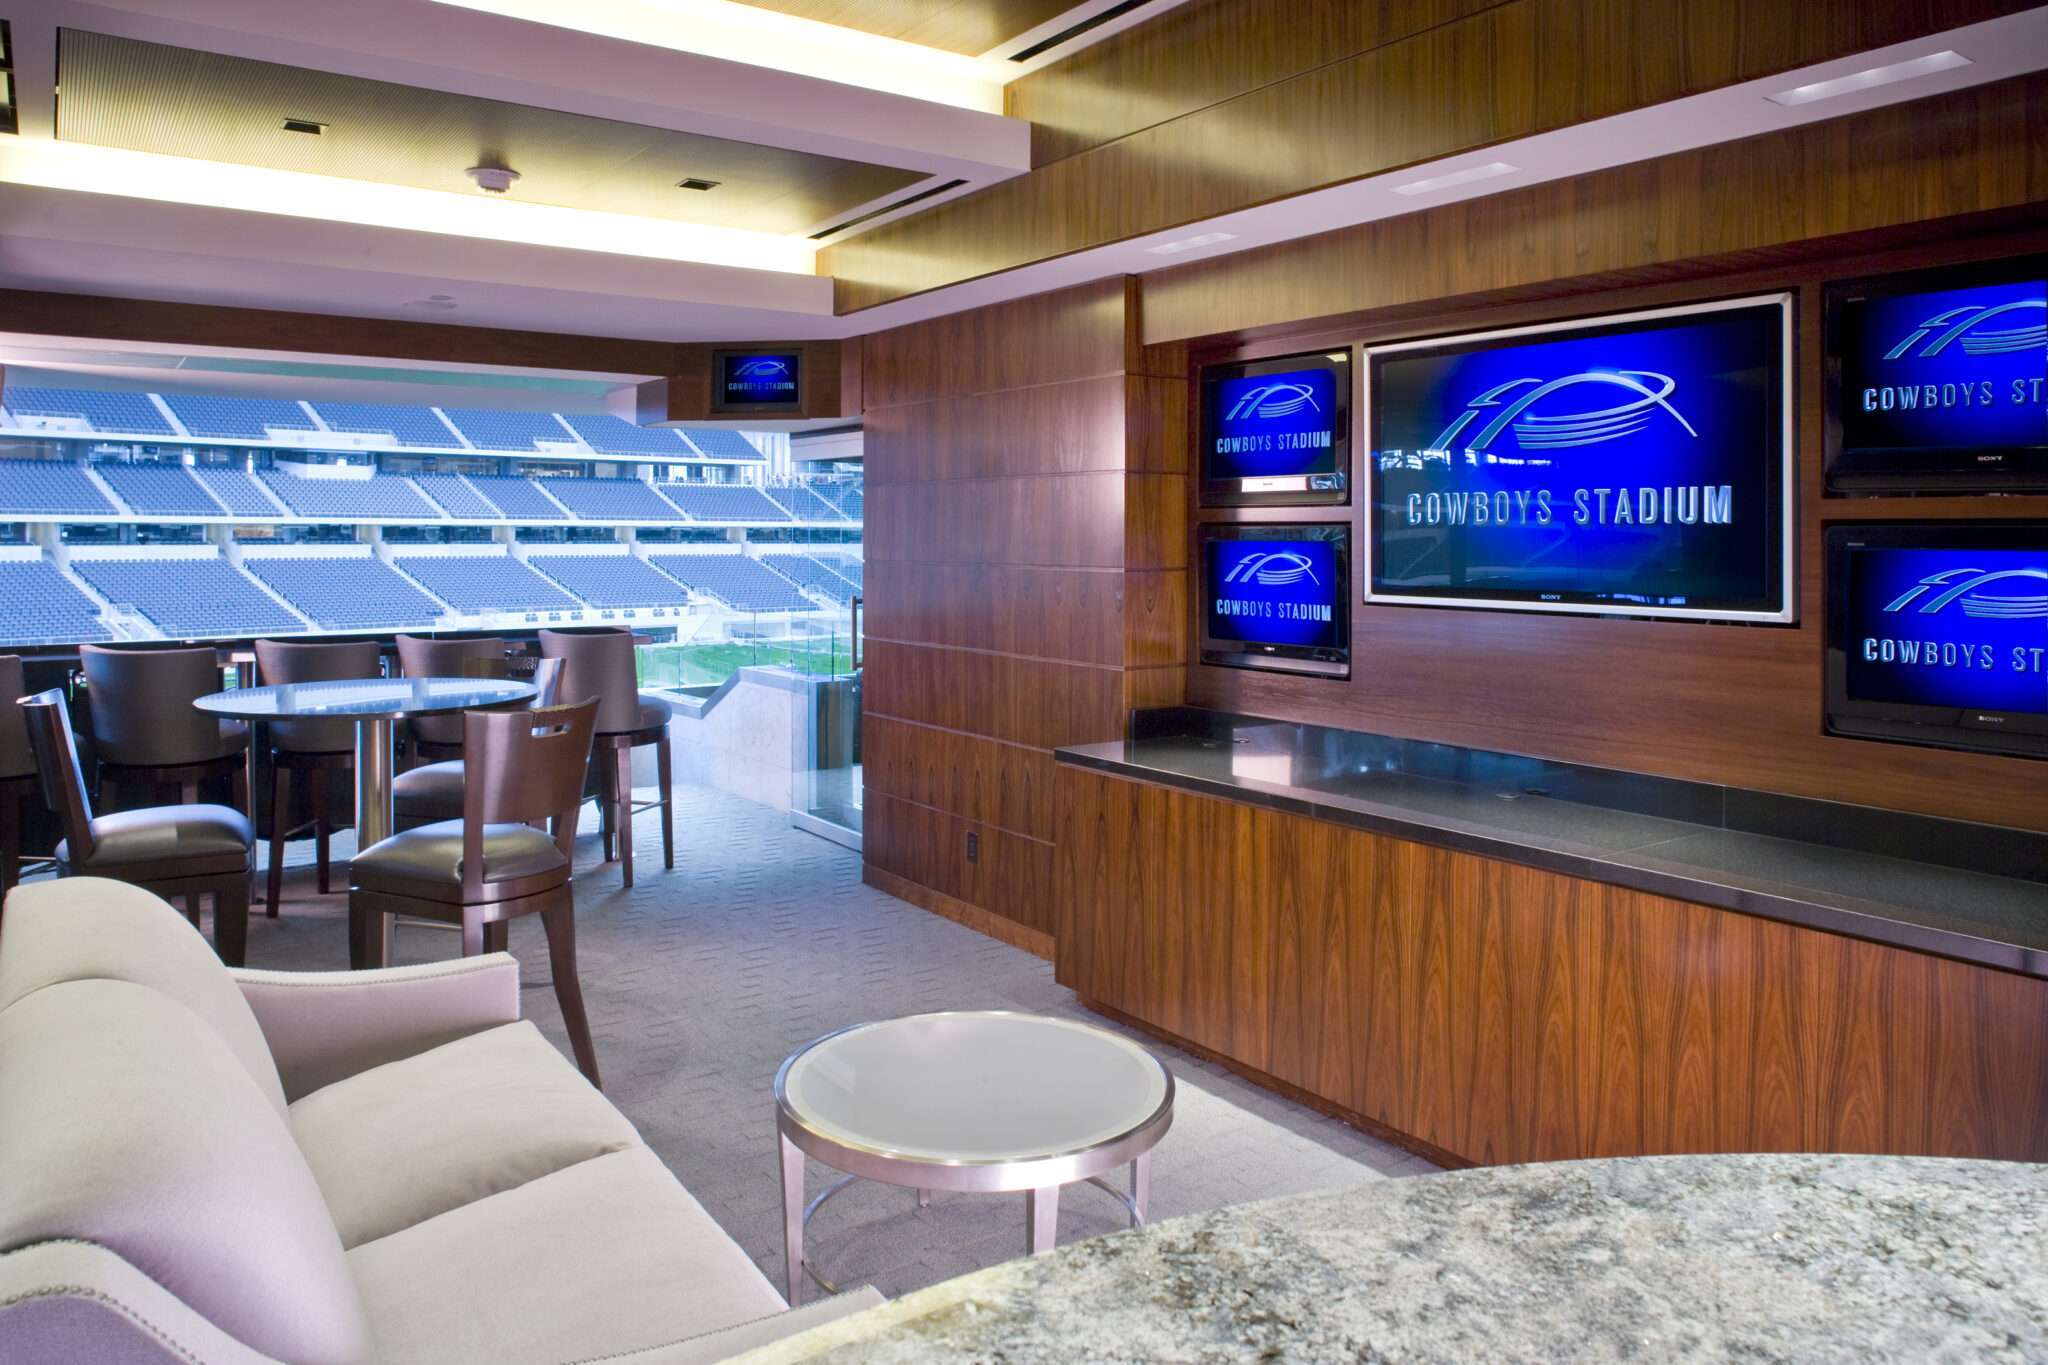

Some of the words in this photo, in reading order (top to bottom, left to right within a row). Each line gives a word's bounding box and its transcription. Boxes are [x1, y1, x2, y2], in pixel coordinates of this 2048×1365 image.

[1863, 381, 1994, 412] COWBOYS
[2011, 377, 2048, 404] ST
[1216, 433, 1272, 454] COWBOYS
[1278, 430, 1332, 450] STADIUM
[1407, 488, 1553, 526] COWBOYS
[1573, 485, 1733, 525] STADIUM
[1216, 599, 1272, 618] COWBOYS
[1278, 602, 1332, 622] STADIUM
[1863, 637, 1994, 670] COWBOYS
[2011, 646, 2048, 673] ST
